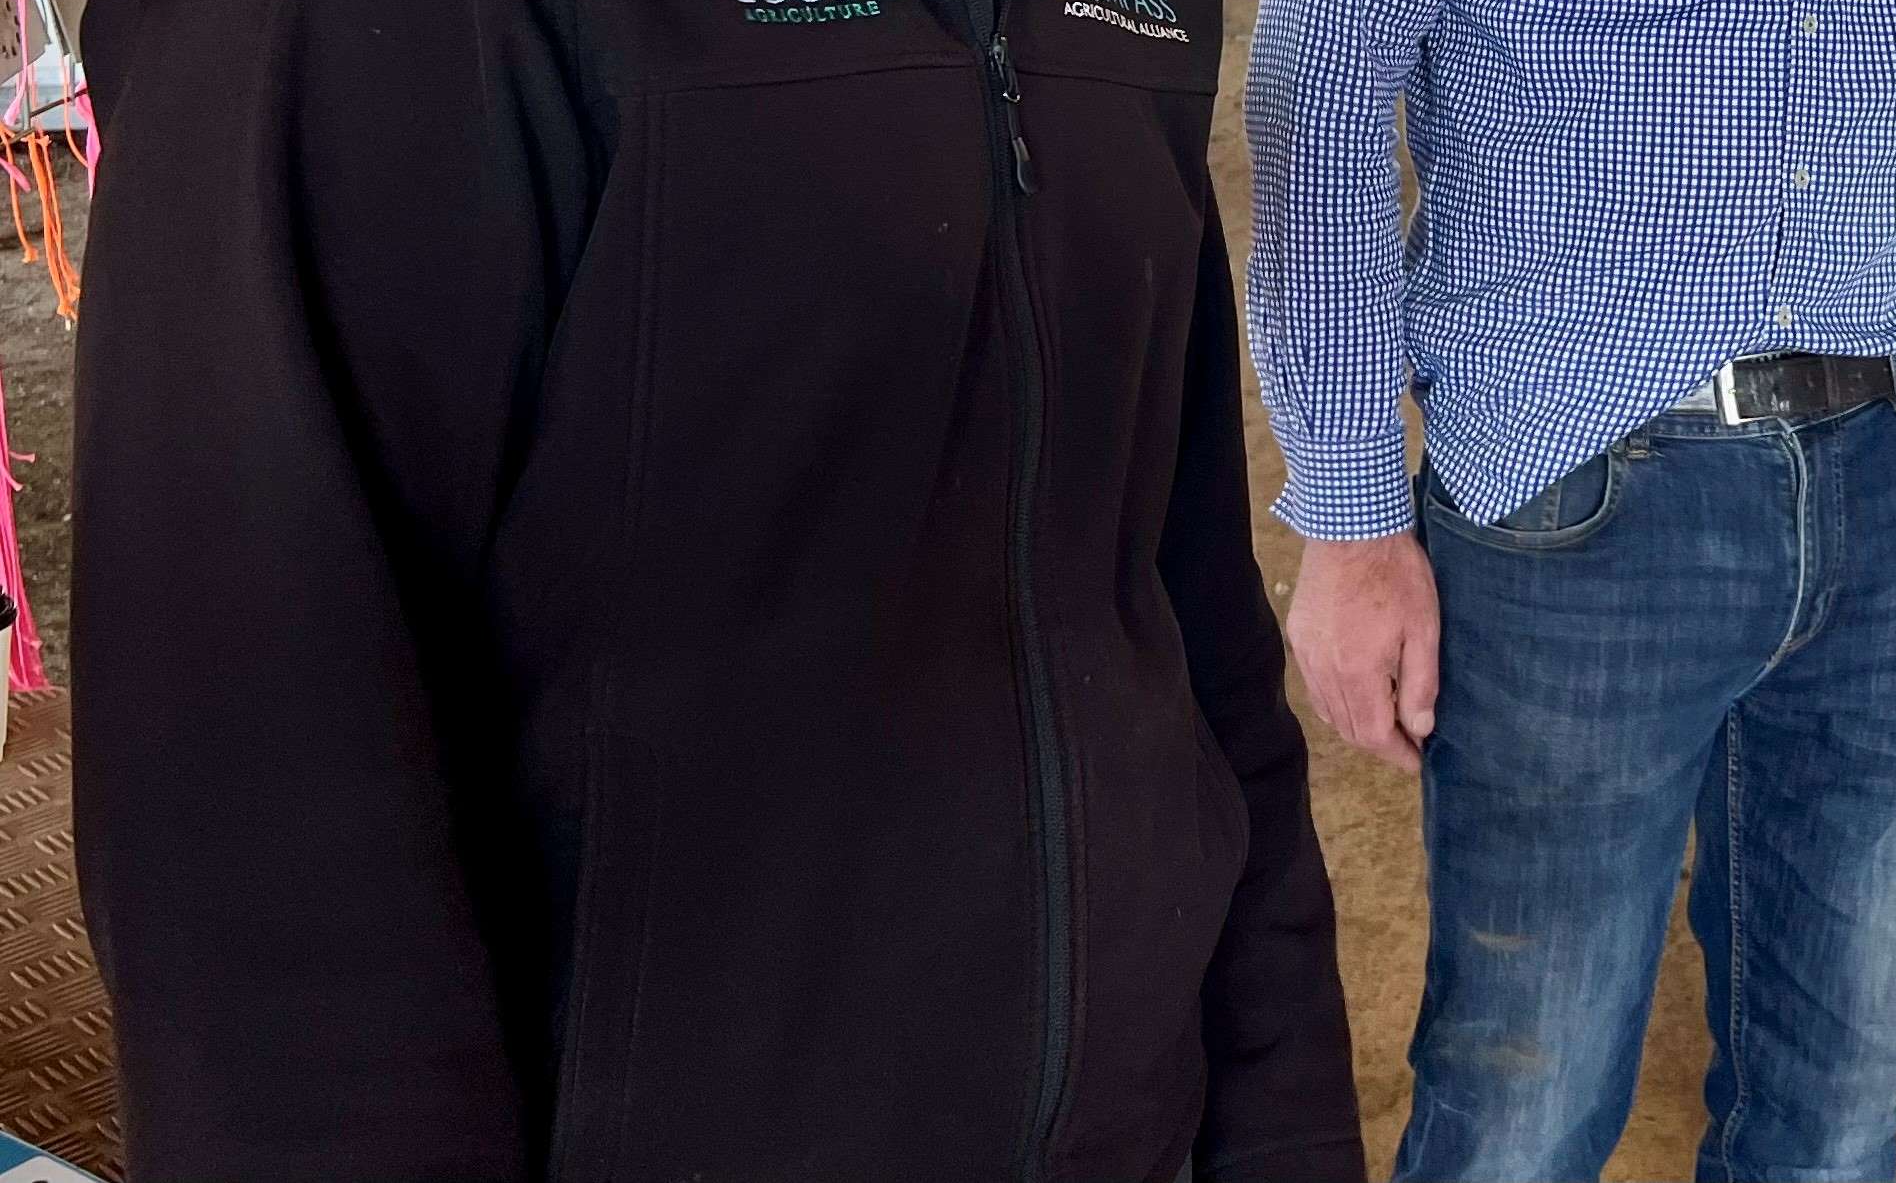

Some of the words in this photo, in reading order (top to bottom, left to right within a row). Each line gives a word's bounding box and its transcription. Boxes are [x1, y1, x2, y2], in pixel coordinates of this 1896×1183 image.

[744, 0, 881, 24] AGRICULTURE
[1063, 0, 1140, 35] AGRICULTURAL
[1139, 22, 1190, 44] ALLIANCE
